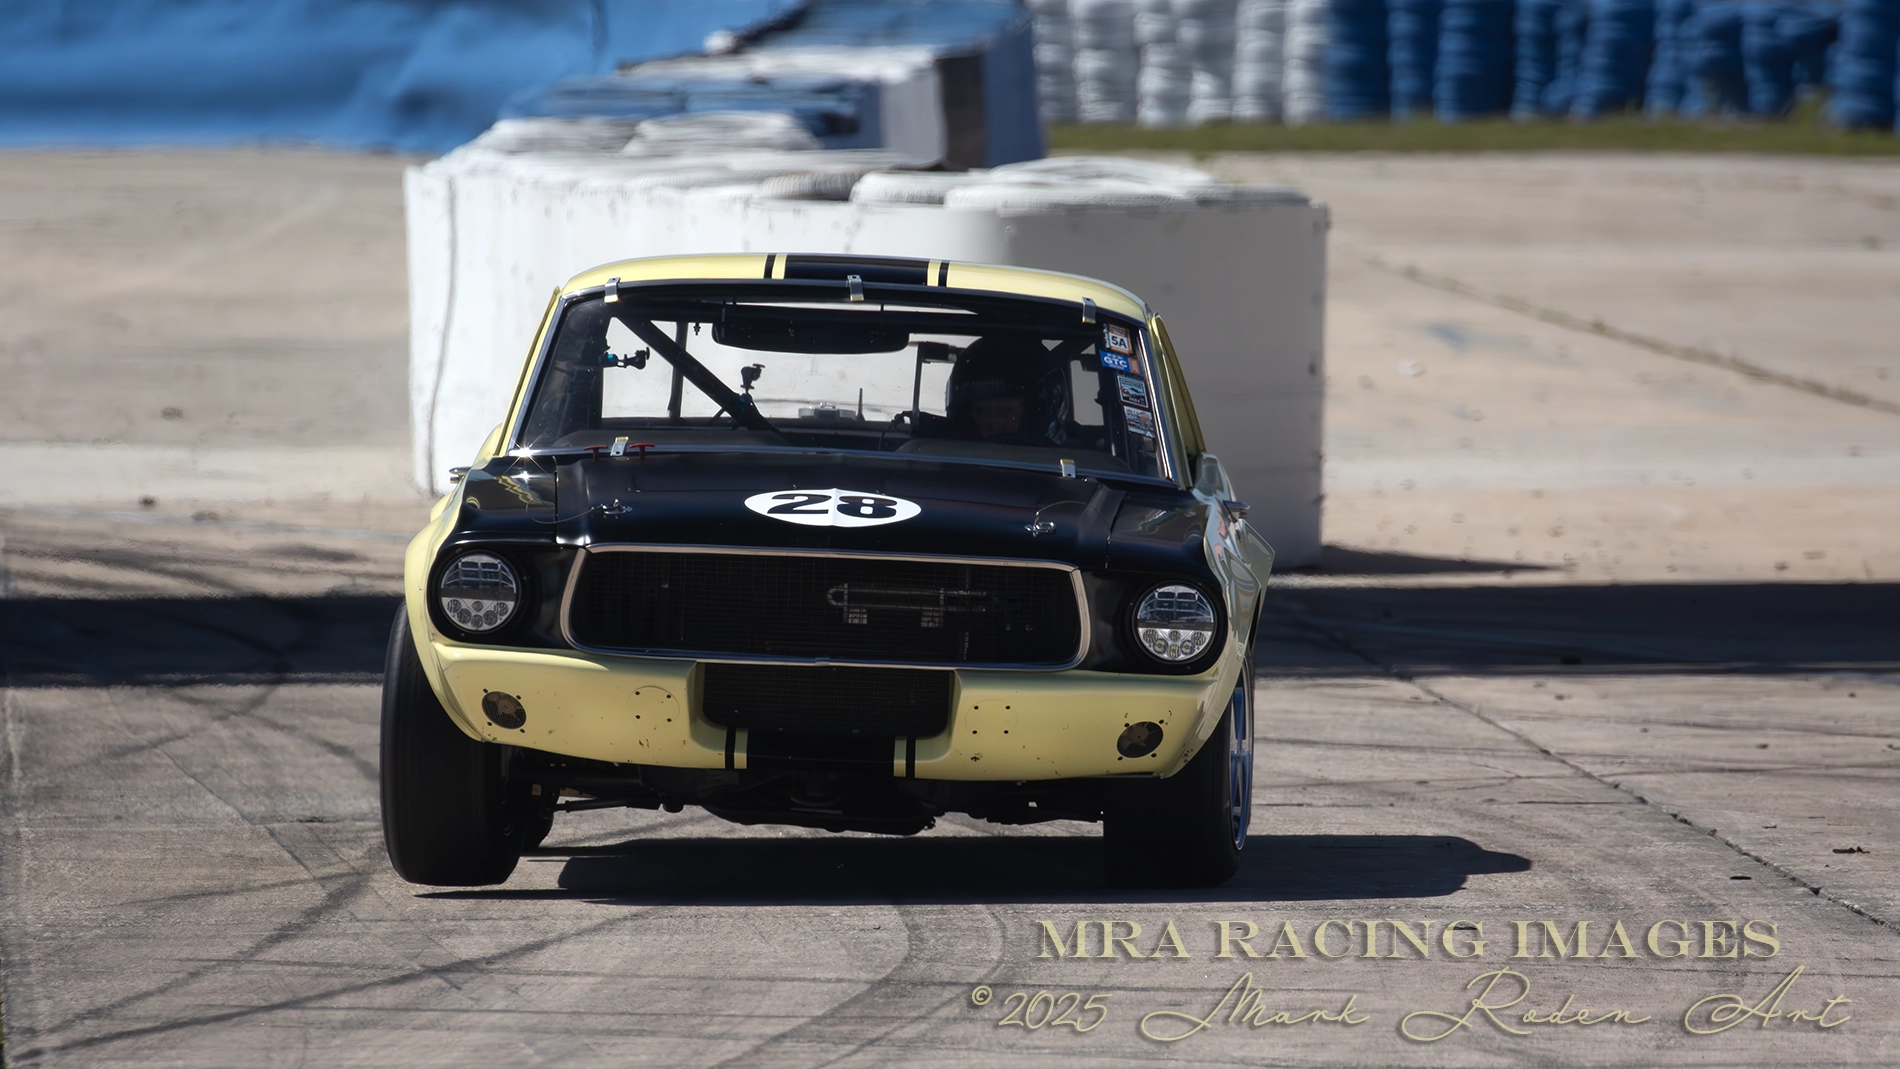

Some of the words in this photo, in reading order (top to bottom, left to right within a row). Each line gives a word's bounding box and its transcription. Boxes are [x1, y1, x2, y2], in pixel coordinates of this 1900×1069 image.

[1111, 335, 1127, 349] 5A
[1103, 356, 1128, 368] GTC
[766, 493, 897, 519] 28
